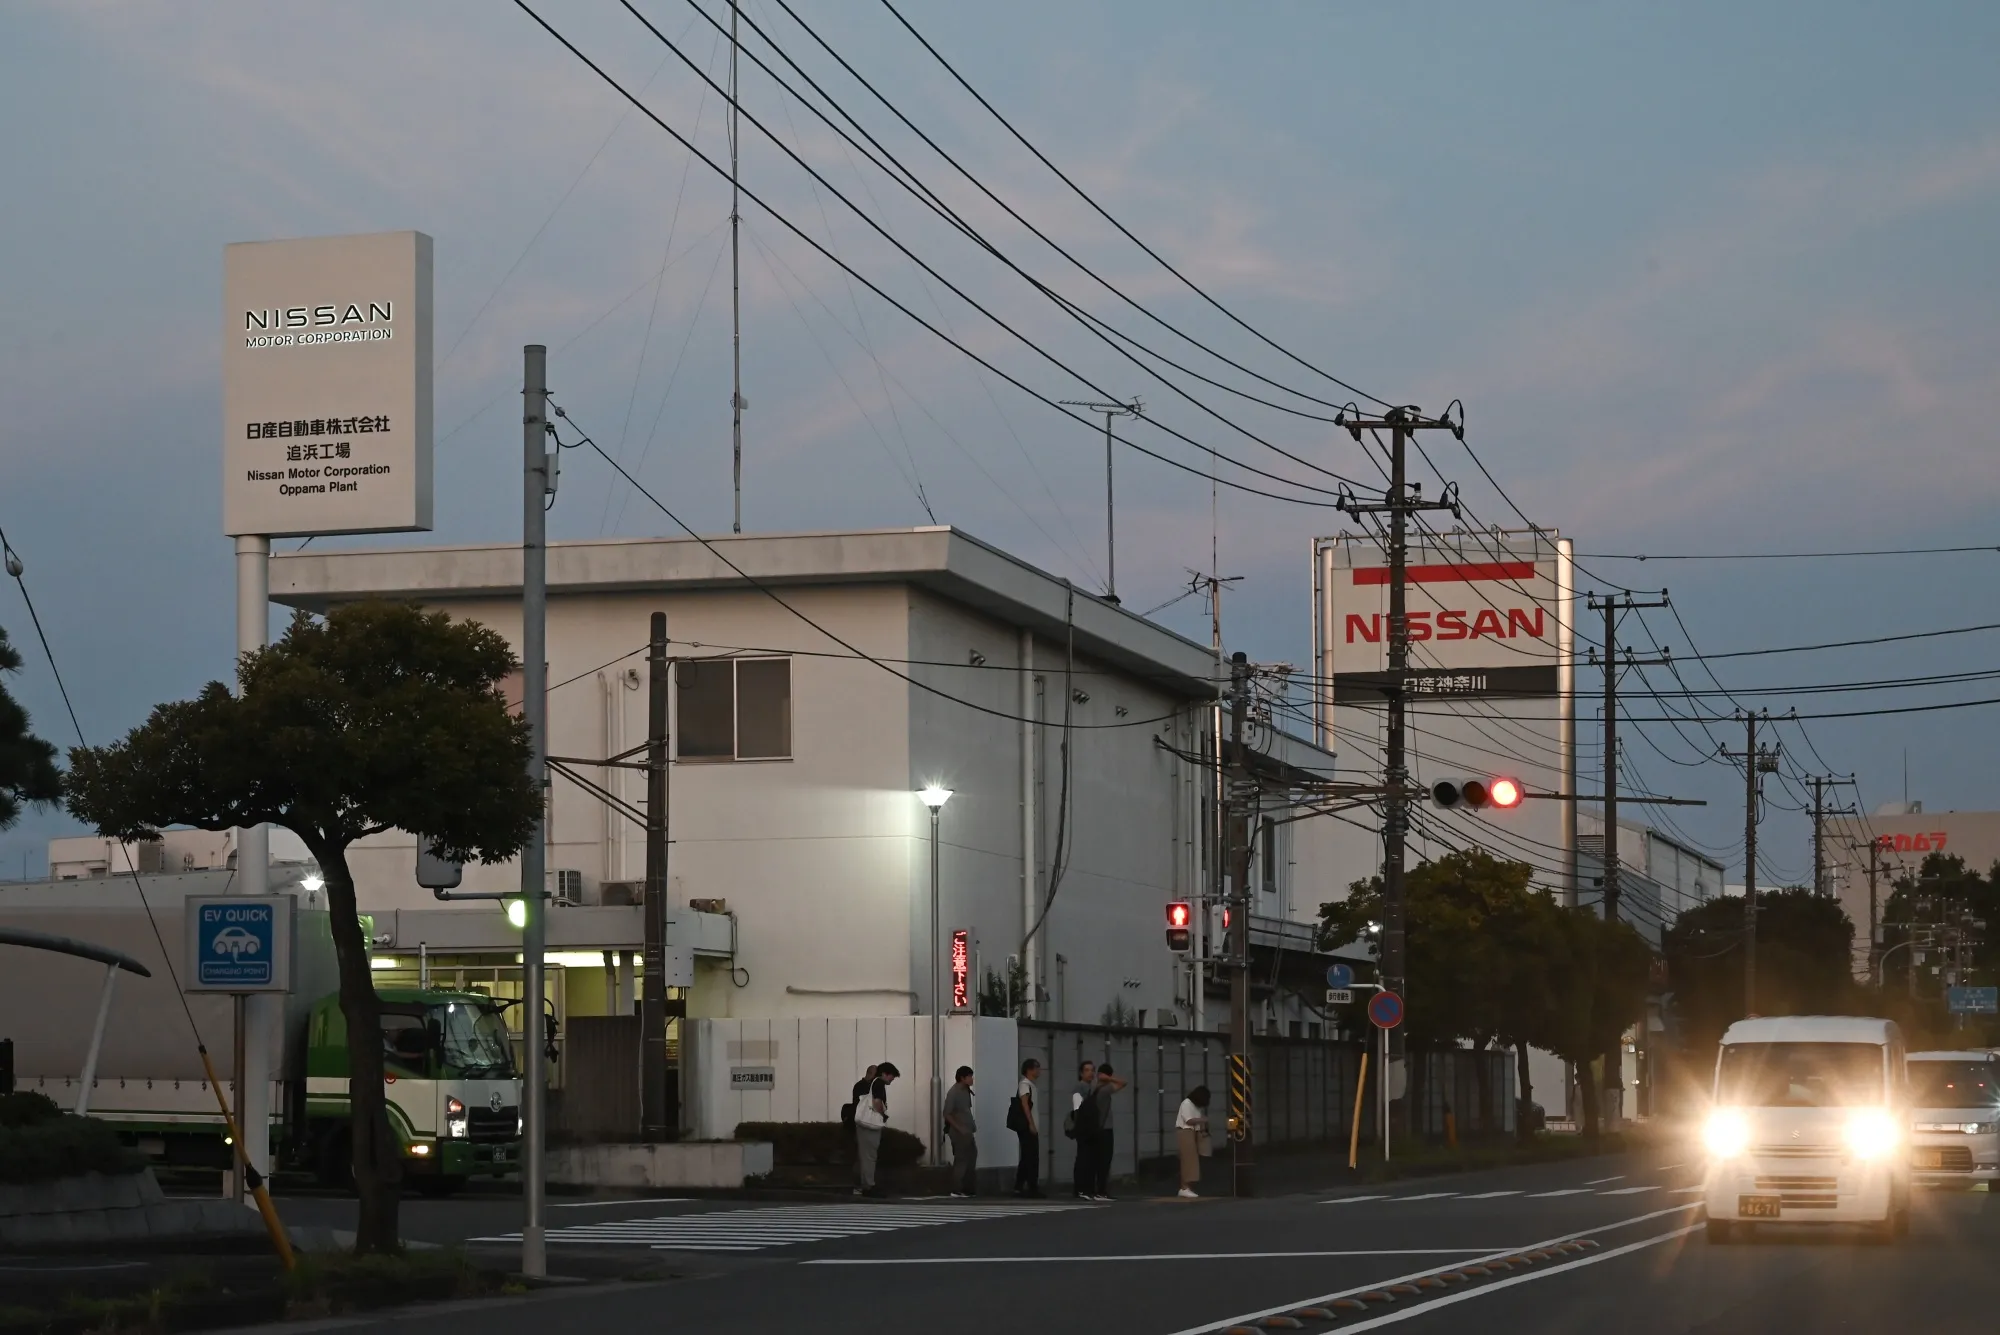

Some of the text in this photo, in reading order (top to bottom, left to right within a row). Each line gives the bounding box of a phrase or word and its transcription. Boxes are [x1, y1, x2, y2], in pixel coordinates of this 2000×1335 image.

[245, 302, 393, 331] NISSAN
[245, 328, 393, 348] MOTOR CORPORATION
[246, 415, 391, 440] 日産自動車株式会社
[286, 442, 351, 462] 追浜工場
[247, 463, 391, 482] Nissan Motor Corporation
[279, 480, 358, 497] Oppama Plant
[204, 909, 269, 922] EV QUICK
[204, 967, 266, 976] CHARGING POINT
